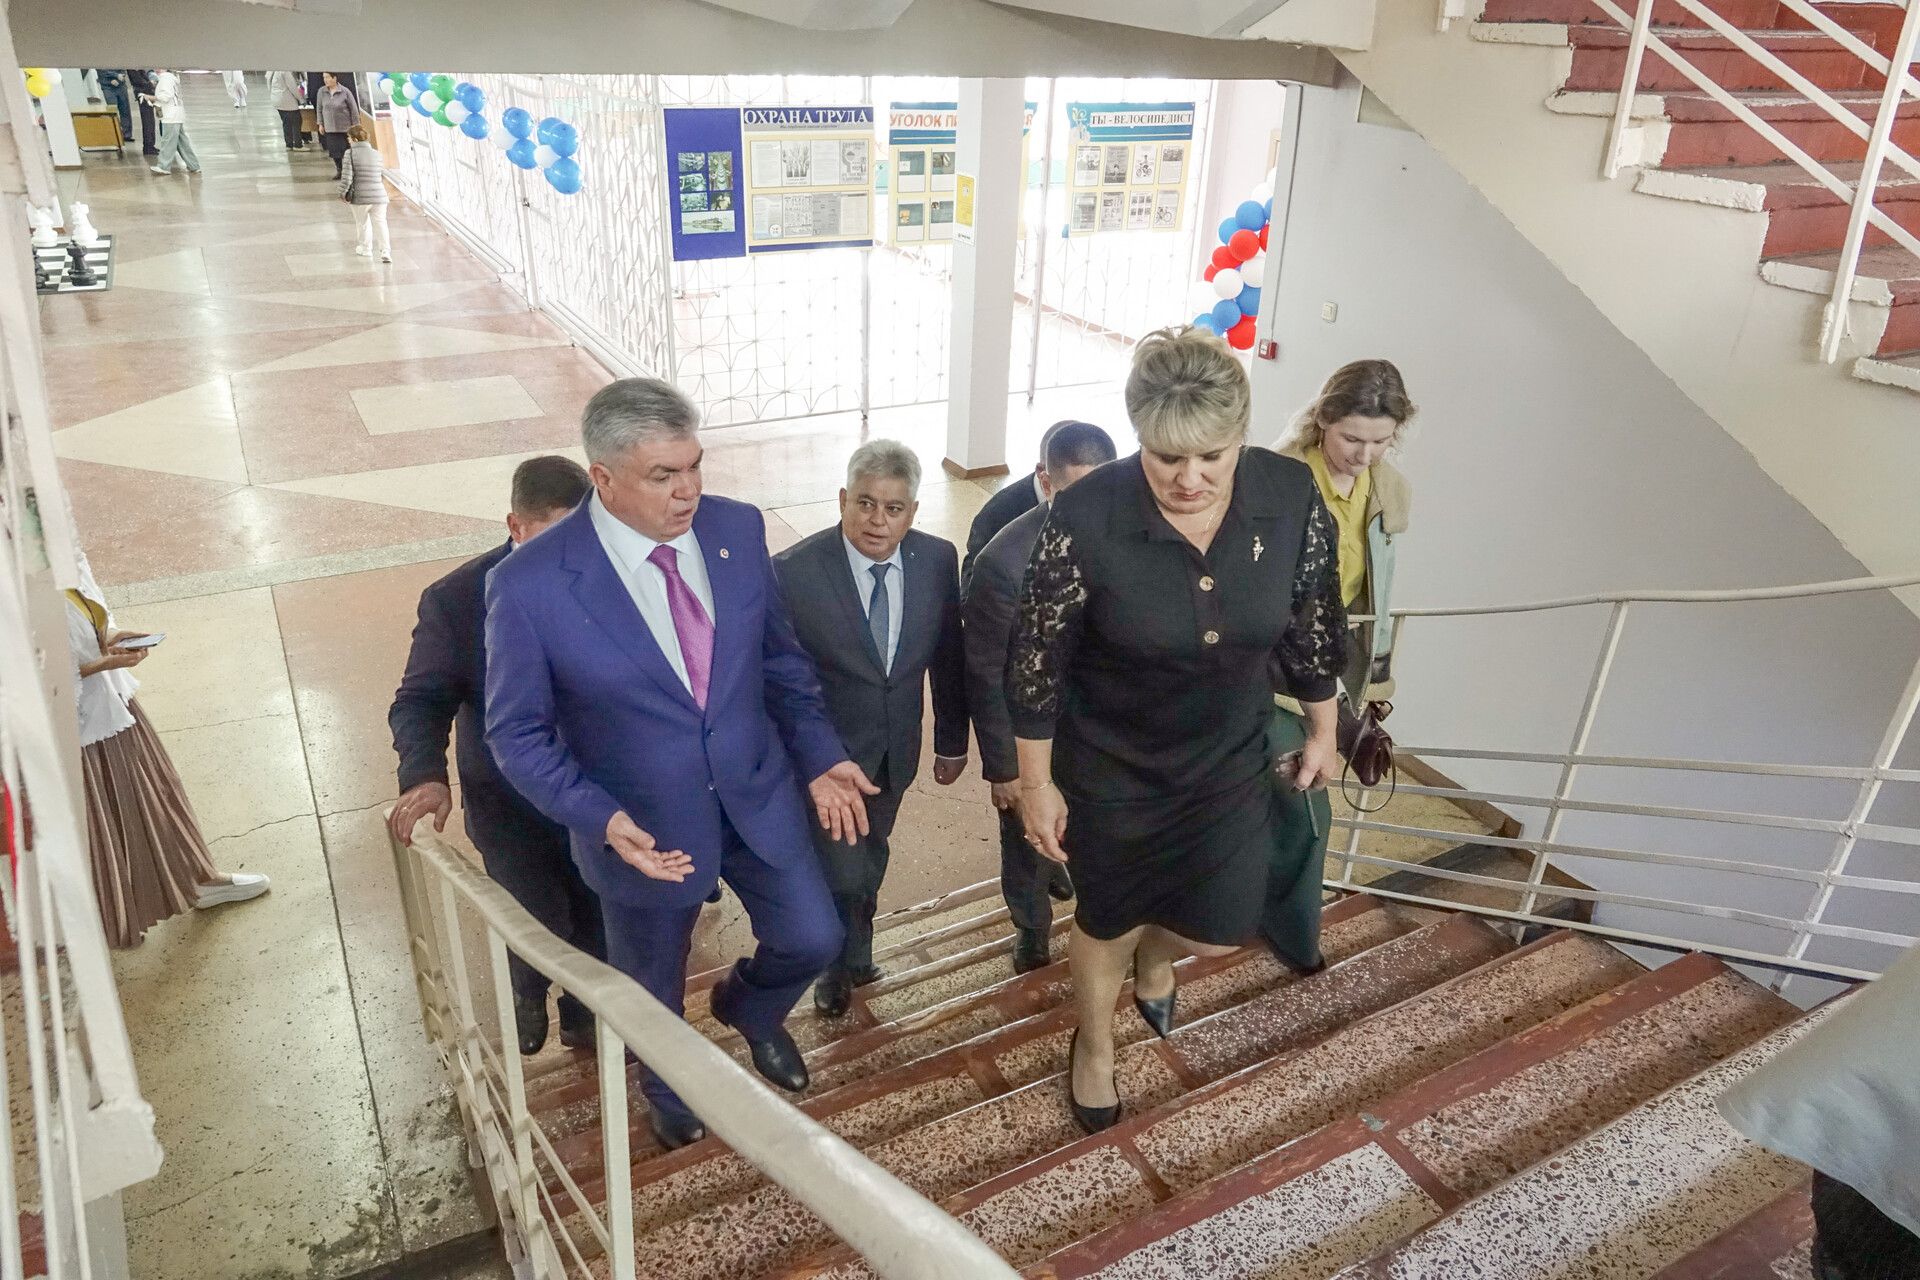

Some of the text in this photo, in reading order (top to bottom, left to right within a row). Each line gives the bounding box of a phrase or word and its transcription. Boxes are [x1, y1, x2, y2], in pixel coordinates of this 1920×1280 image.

[744, 109, 869, 124] ОХРАНА ТРУДА
[889, 113, 942, 128] УГОЛОК
[1114, 113, 1192, 125] ВЕЛОСИПЕДИСТ
